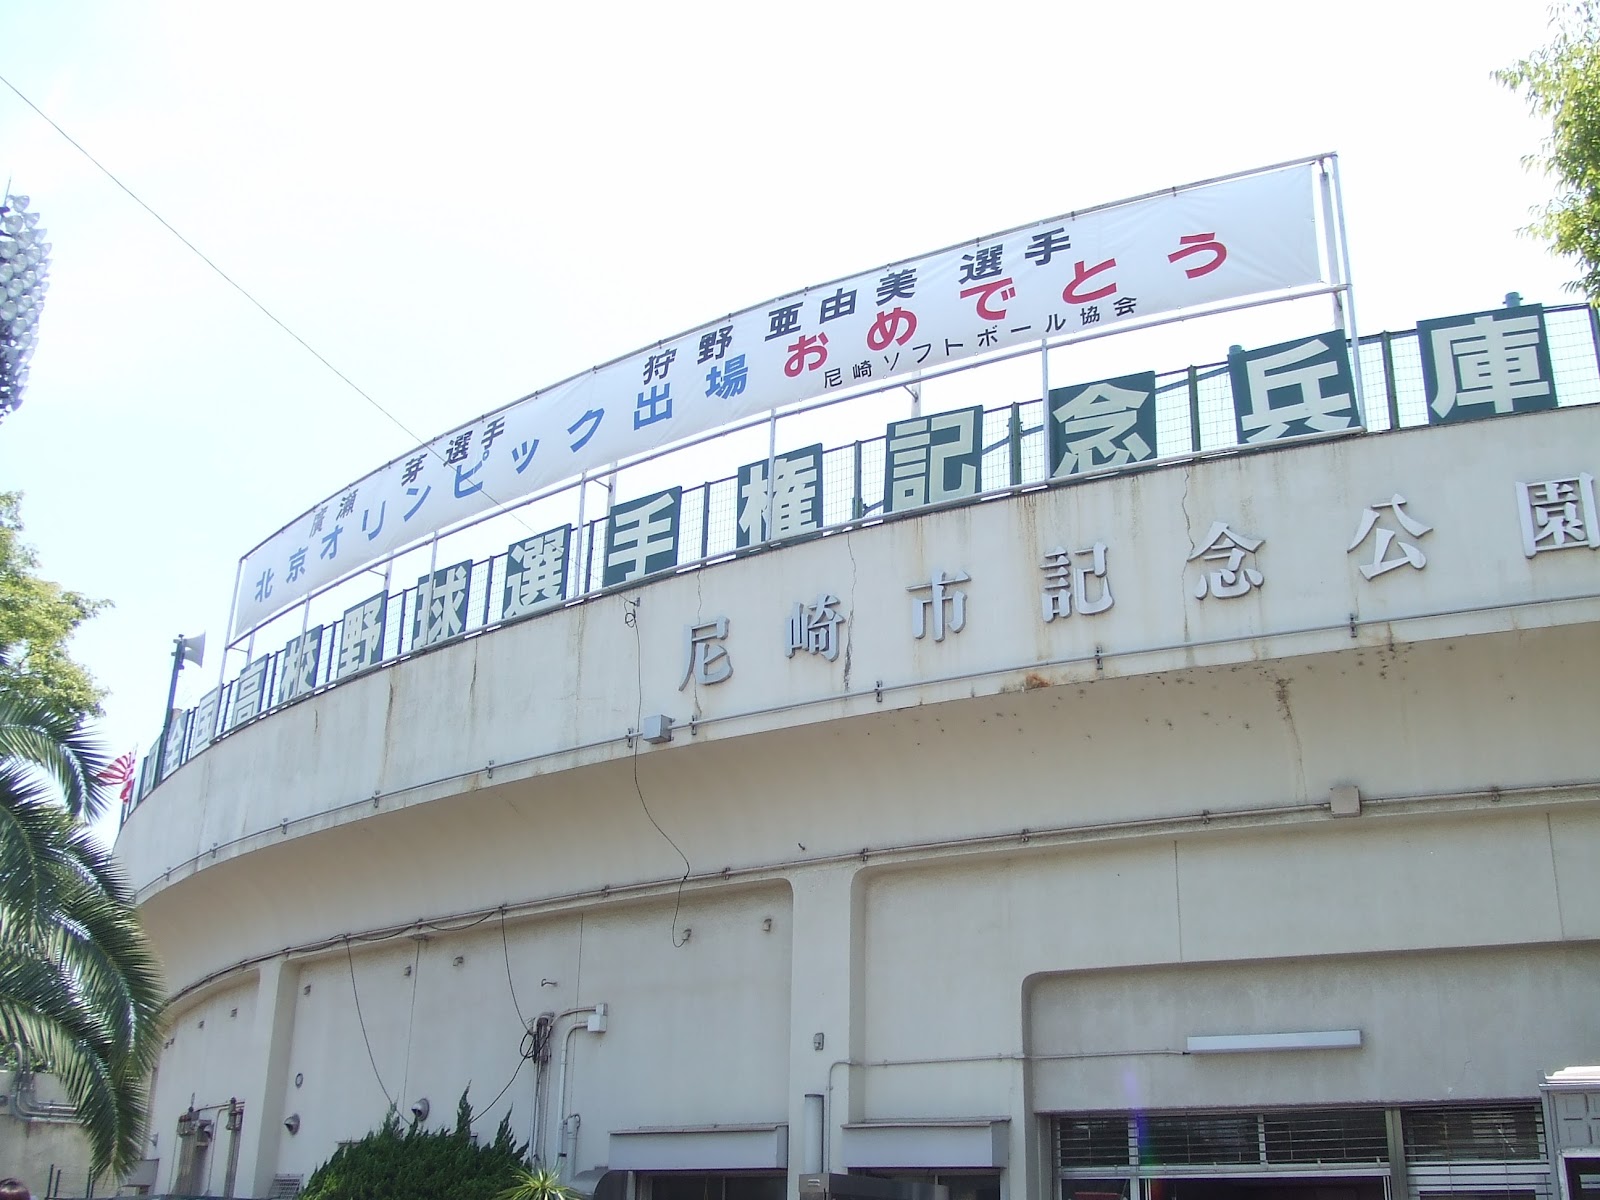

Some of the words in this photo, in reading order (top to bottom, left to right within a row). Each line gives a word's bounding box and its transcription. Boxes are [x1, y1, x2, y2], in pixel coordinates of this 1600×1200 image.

[824, 296, 1137, 388] 尼崎ソフトボール協会
[678, 471, 1600, 692] 尼崎市記念公園
